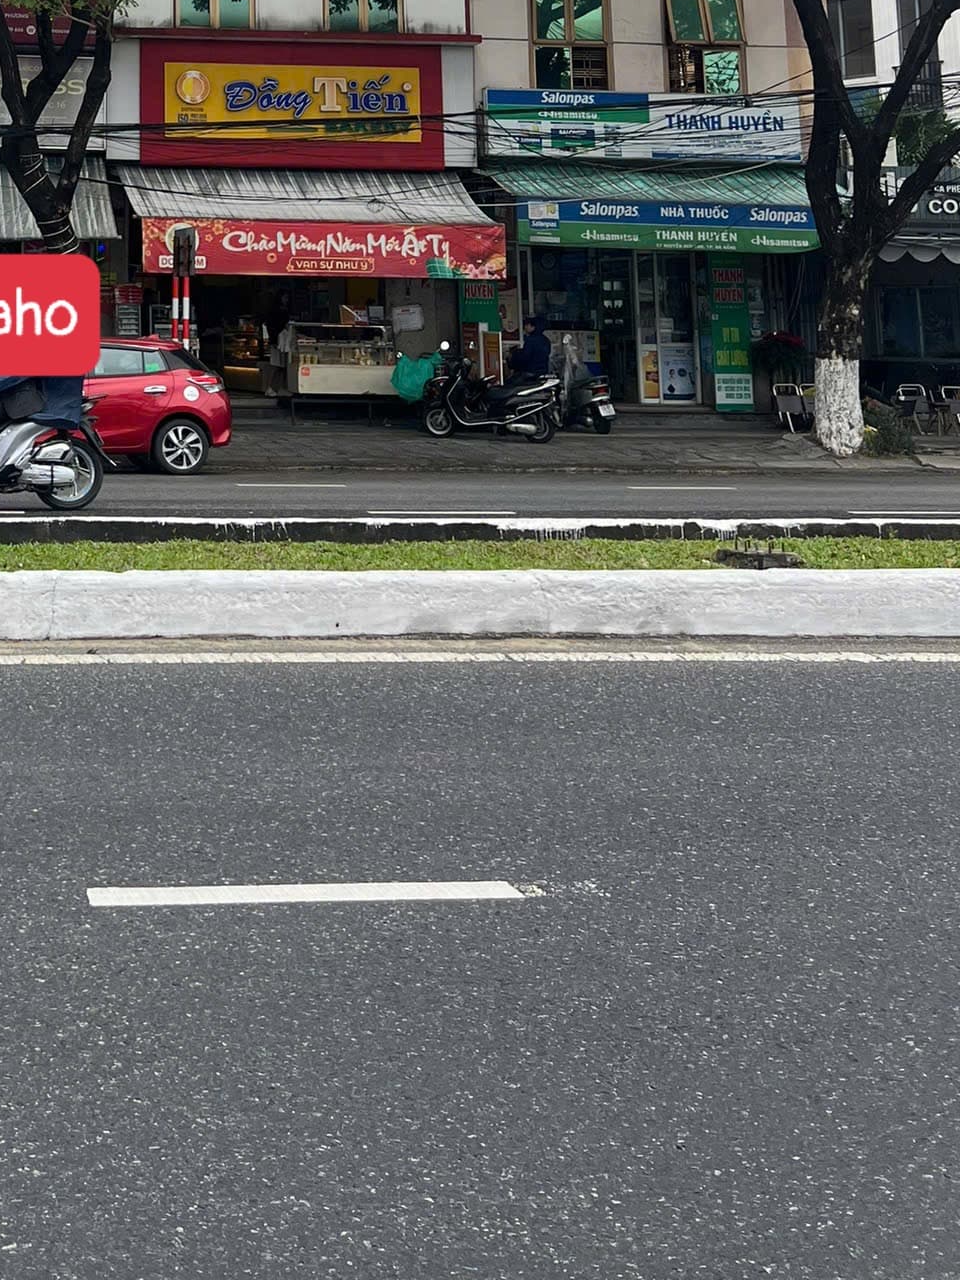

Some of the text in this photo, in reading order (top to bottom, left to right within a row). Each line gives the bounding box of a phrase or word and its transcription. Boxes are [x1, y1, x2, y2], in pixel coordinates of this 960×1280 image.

[224, 73, 410, 119] Đồng Tiến
[541, 91, 595, 106] Salonpas
[664, 109, 784, 132] THANH HUYỀN
[580, 202, 808, 224] Salonpas NHÀ THUỐC Salonpas
[928, 199, 960, 214] CO
[222, 231, 277, 252] Chào
[276, 231, 326, 258] Mừng
[326, 232, 366, 257] Năm
[367, 233, 402, 257] Mới
[581, 230, 639, 242] Hisamitsu
[655, 230, 693, 241] THANH
[751, 235, 809, 247] Hisamitsu
